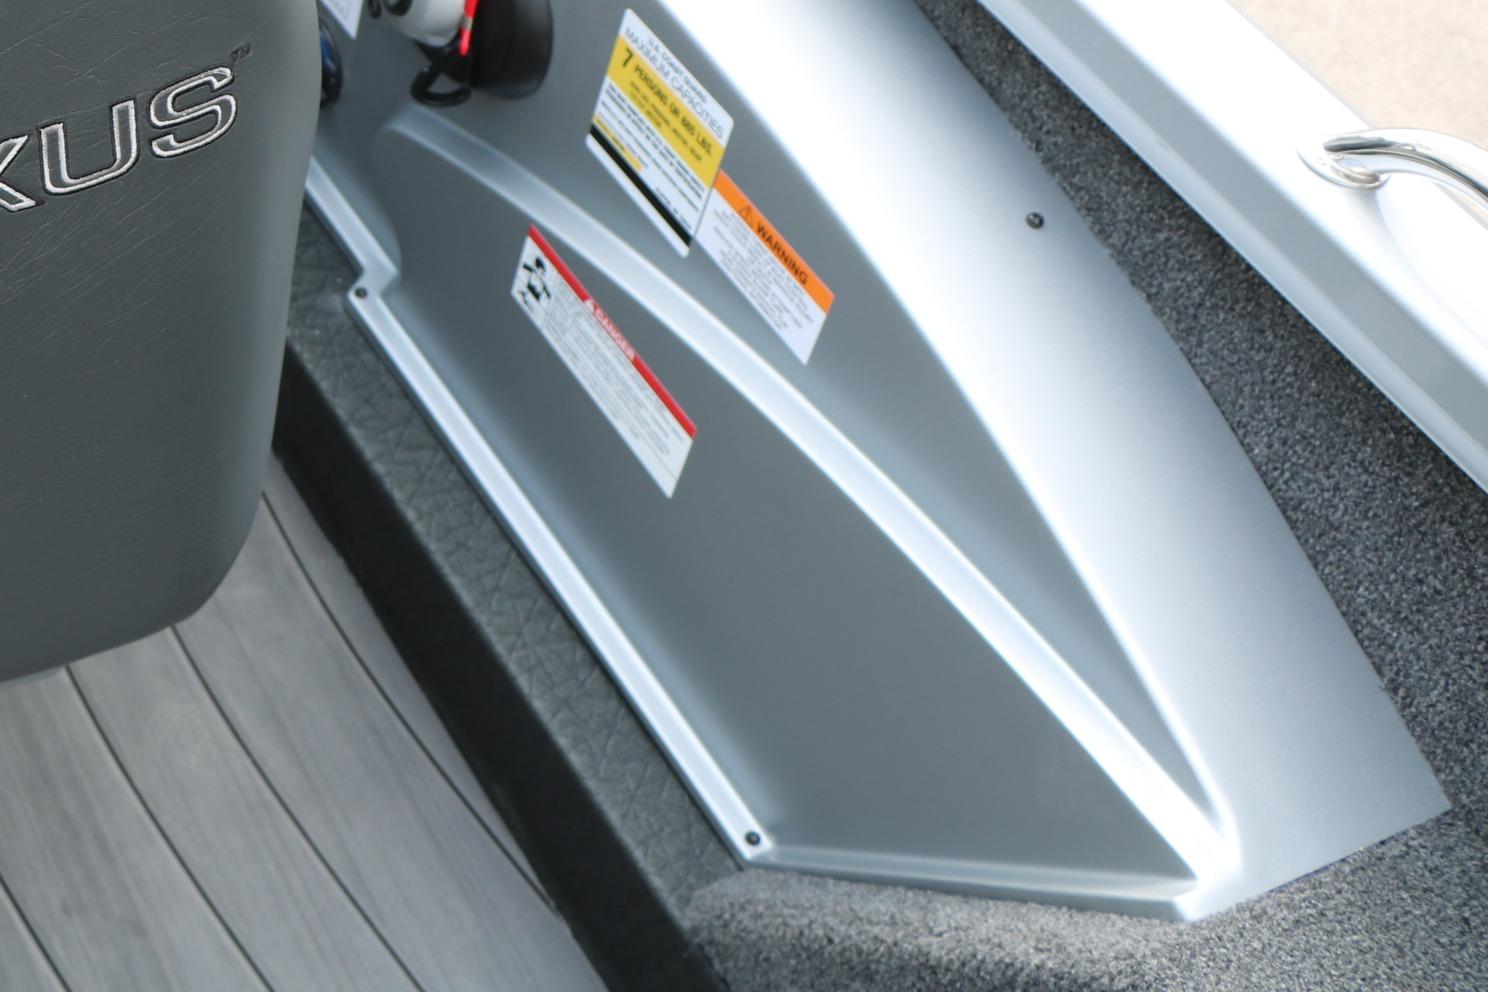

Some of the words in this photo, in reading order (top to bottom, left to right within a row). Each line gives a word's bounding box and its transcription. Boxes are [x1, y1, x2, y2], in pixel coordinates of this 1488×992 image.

[622, 47, 634, 68] 7
[633, 64, 668, 107] PERSONS
[624, 25, 671, 81] MAXIMUM
[671, 76, 723, 139] CAPACITIES
[757, 223, 808, 285] WARNING
[594, 307, 635, 360] DANGER
